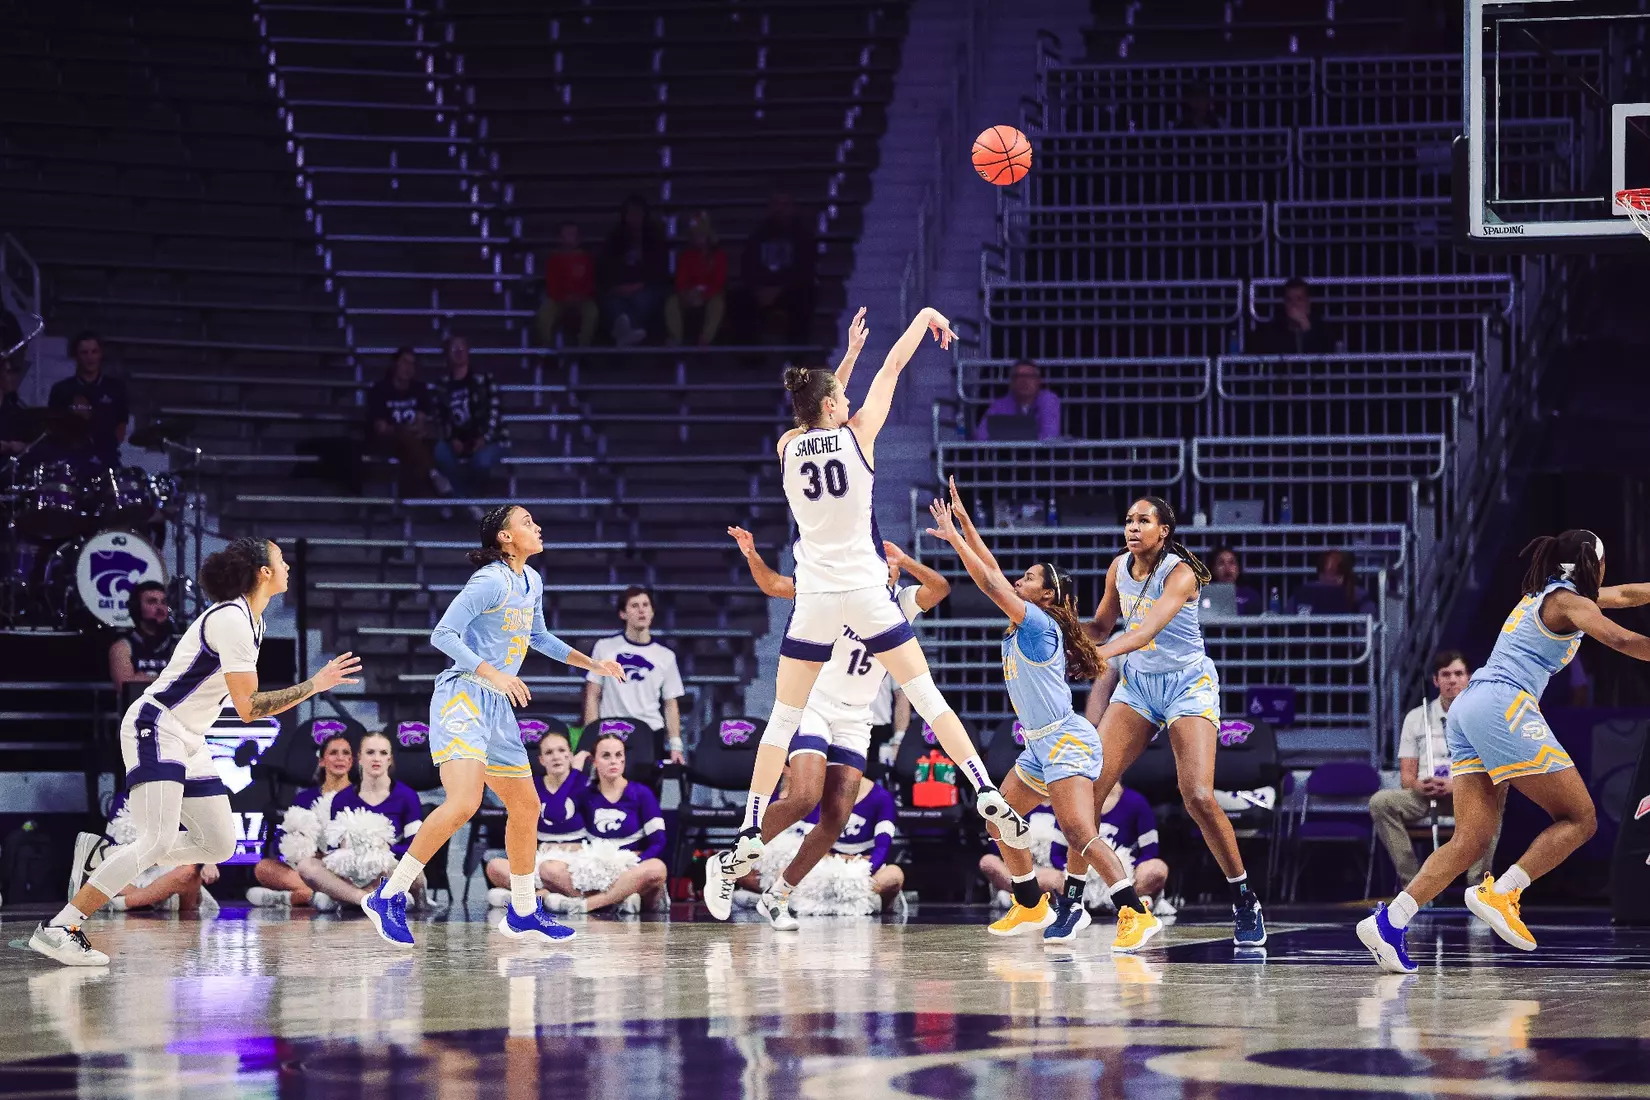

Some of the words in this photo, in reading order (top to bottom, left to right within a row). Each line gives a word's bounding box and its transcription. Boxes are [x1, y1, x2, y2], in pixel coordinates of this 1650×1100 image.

[1483, 225, 1524, 236] SPALDING
[795, 434, 842, 457] SANCHEZ
[800, 458, 849, 501] 30
[846, 648, 873, 676] 15
